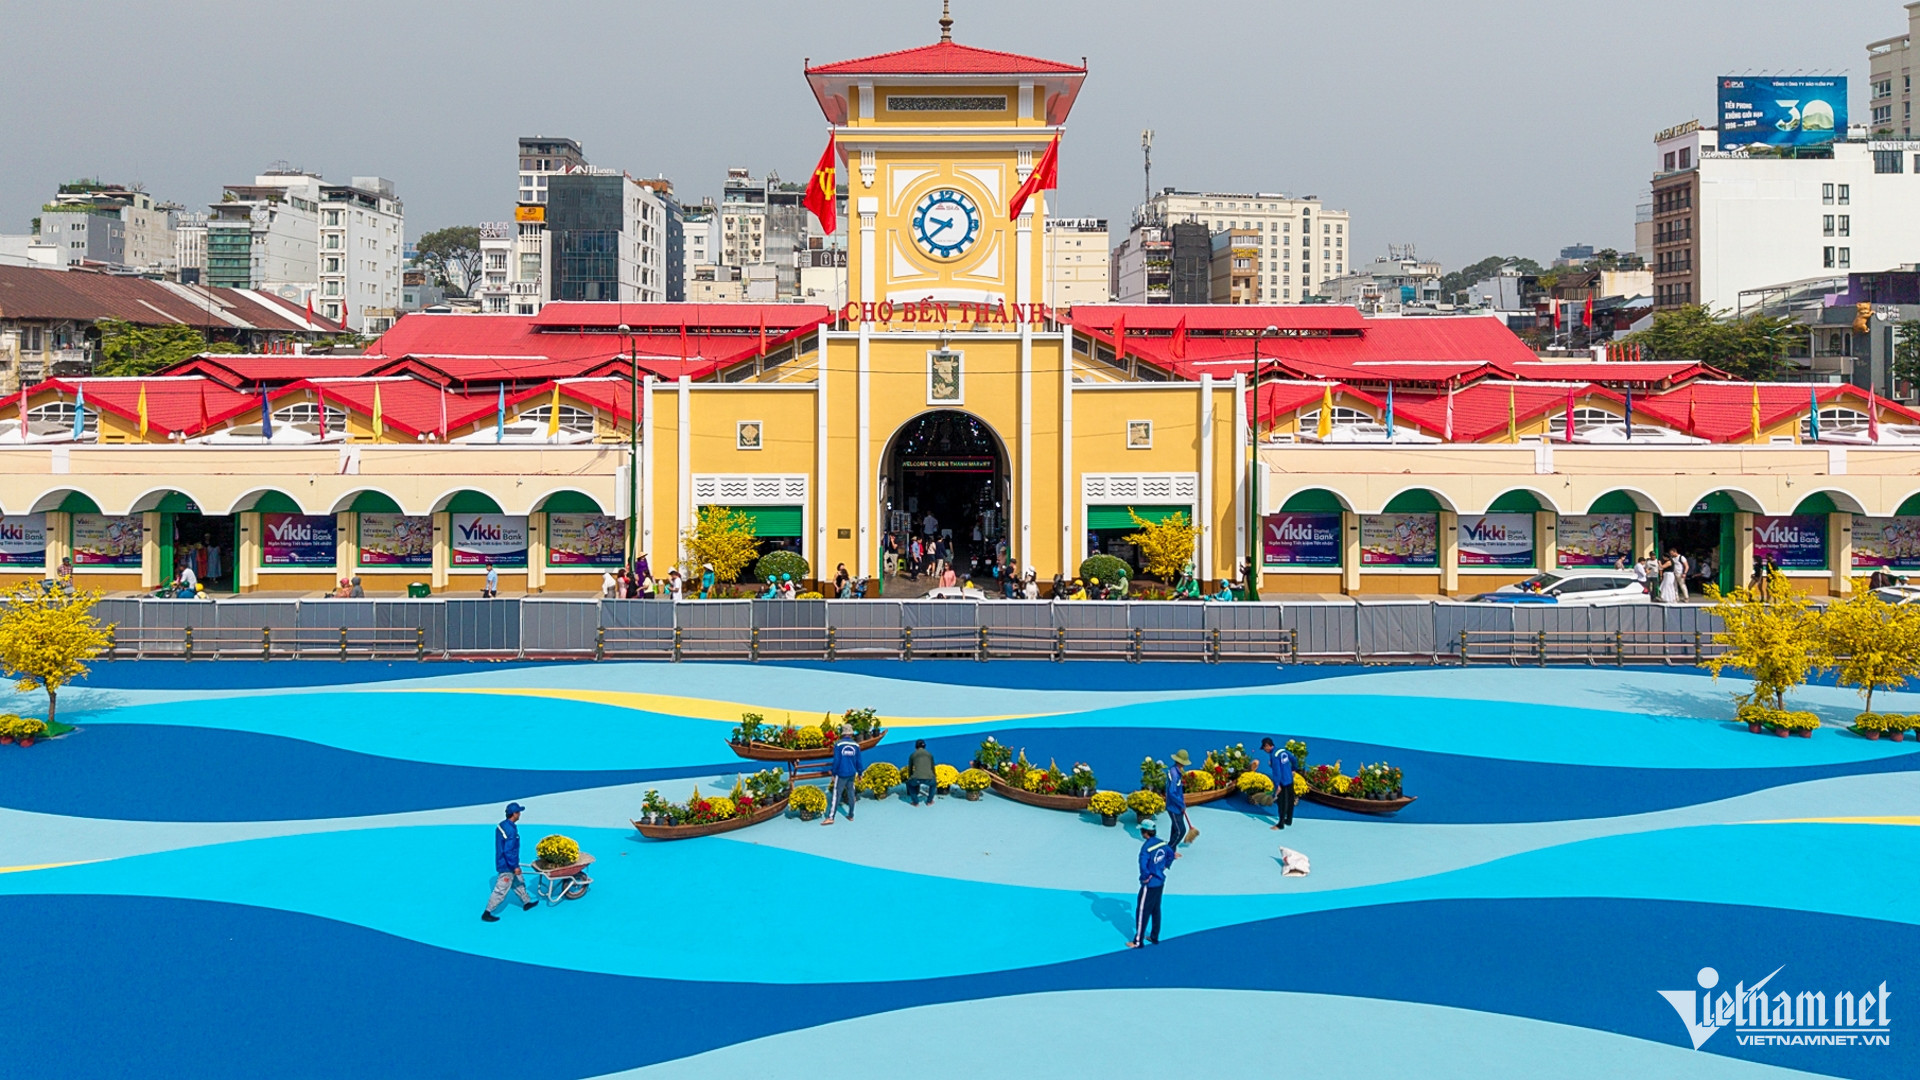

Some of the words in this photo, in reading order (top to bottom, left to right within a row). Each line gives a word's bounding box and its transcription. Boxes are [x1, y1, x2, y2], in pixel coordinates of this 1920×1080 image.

[1775, 99, 1834, 132] 30
[940, 190, 954, 201] 12
[846, 299, 894, 325] CHỢ
[902, 295, 949, 323] BẾN
[960, 297, 1045, 324] THÀNH
[268, 517, 311, 541] Vikki
[458, 517, 501, 541] Vikki
[1269, 516, 1312, 540] Vikki
[1463, 517, 1505, 541] Vikki
[1755, 519, 1798, 543] Vikki
[1800, 536, 1820, 544] Bank
